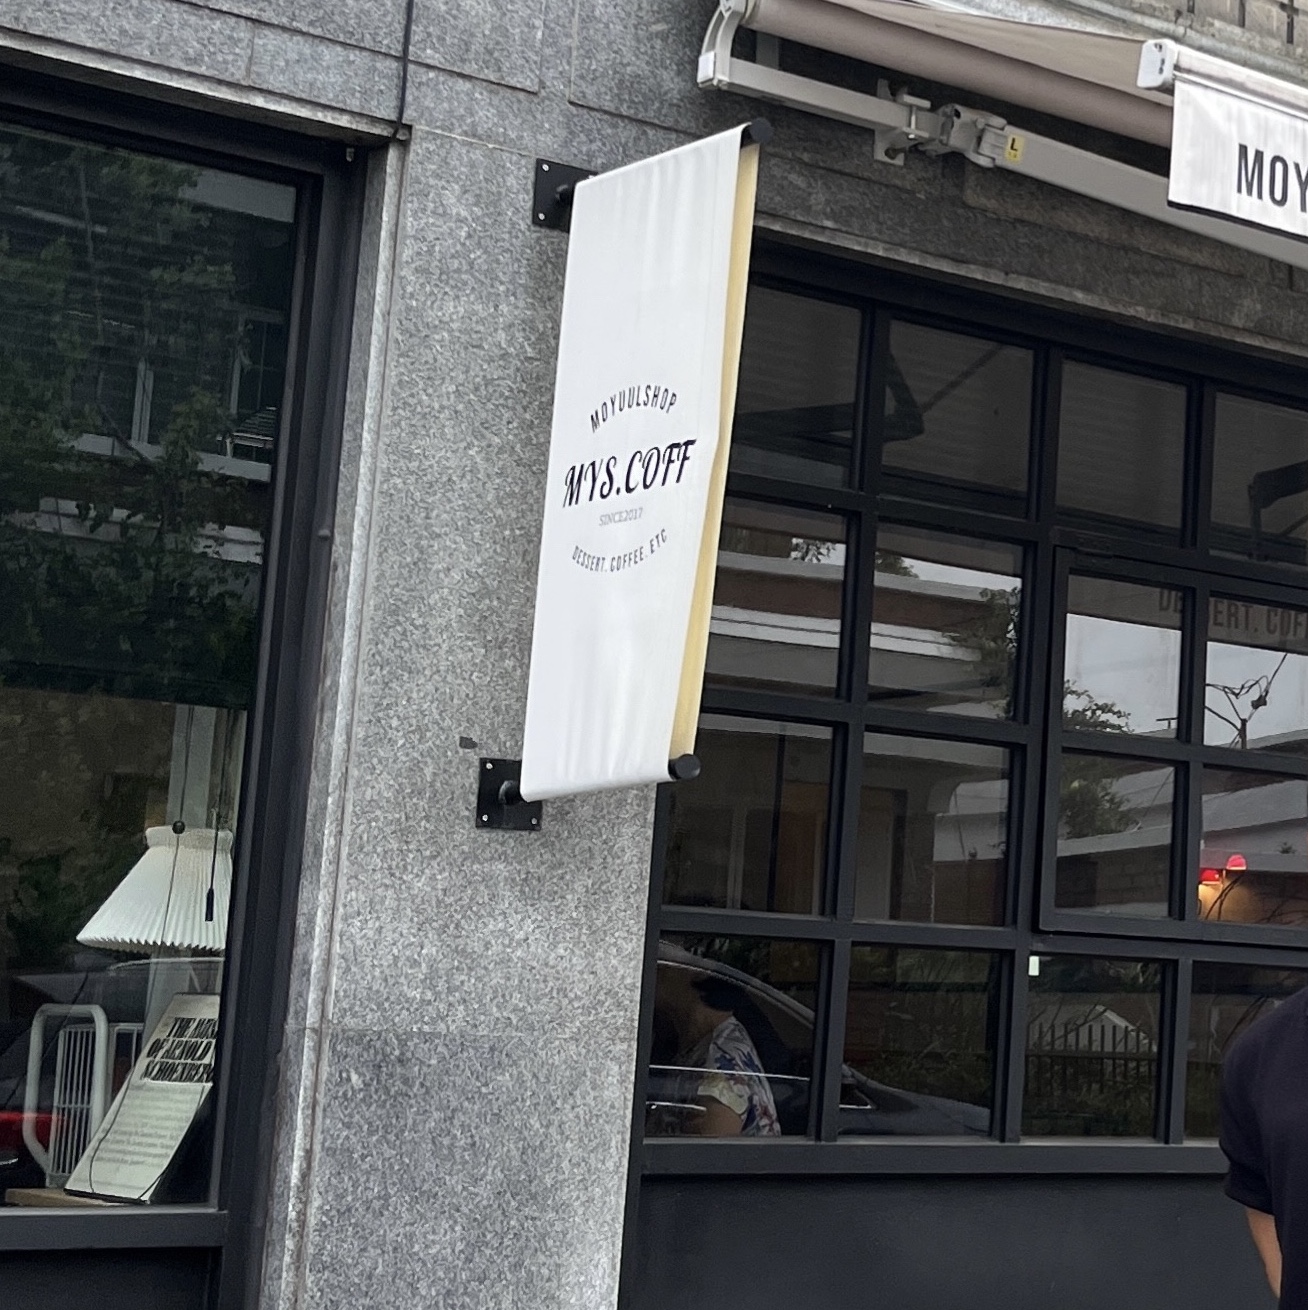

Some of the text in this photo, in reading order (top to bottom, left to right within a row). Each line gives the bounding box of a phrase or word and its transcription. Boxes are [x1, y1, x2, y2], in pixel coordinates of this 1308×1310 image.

[1010, 137, 1018, 151] L
[591, 384, 677, 433] MOYUULSHOP
[563, 439, 696, 508] MYS.COFF
[650, 528, 667, 554] ETC
